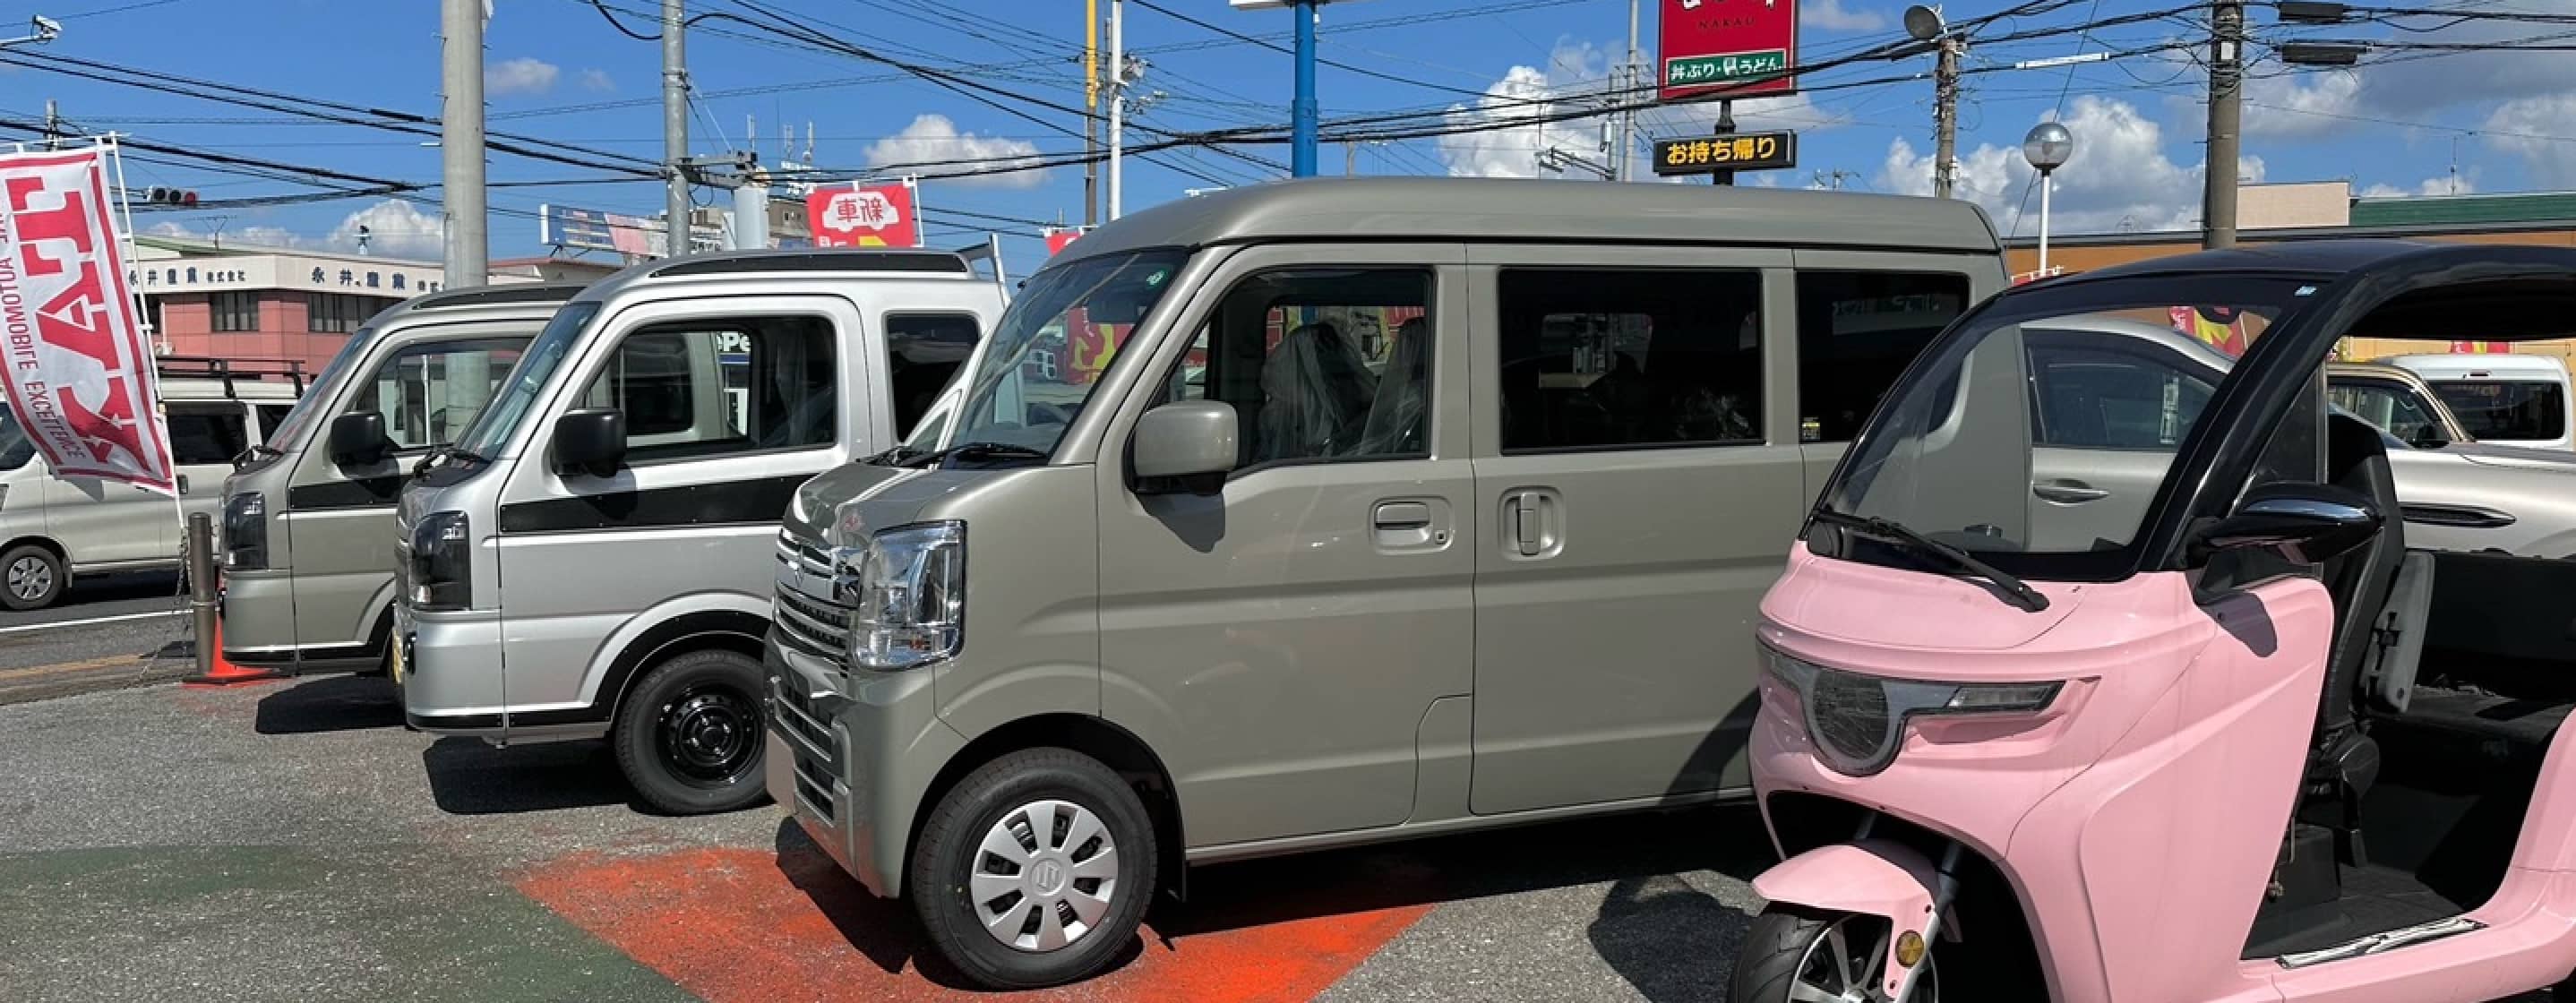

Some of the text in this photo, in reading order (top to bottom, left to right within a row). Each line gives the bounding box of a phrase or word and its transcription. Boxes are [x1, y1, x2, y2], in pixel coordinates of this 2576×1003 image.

[1699, 18, 1756, 29] NAKAU
[1667, 136, 1776, 165] お持ち帰り
